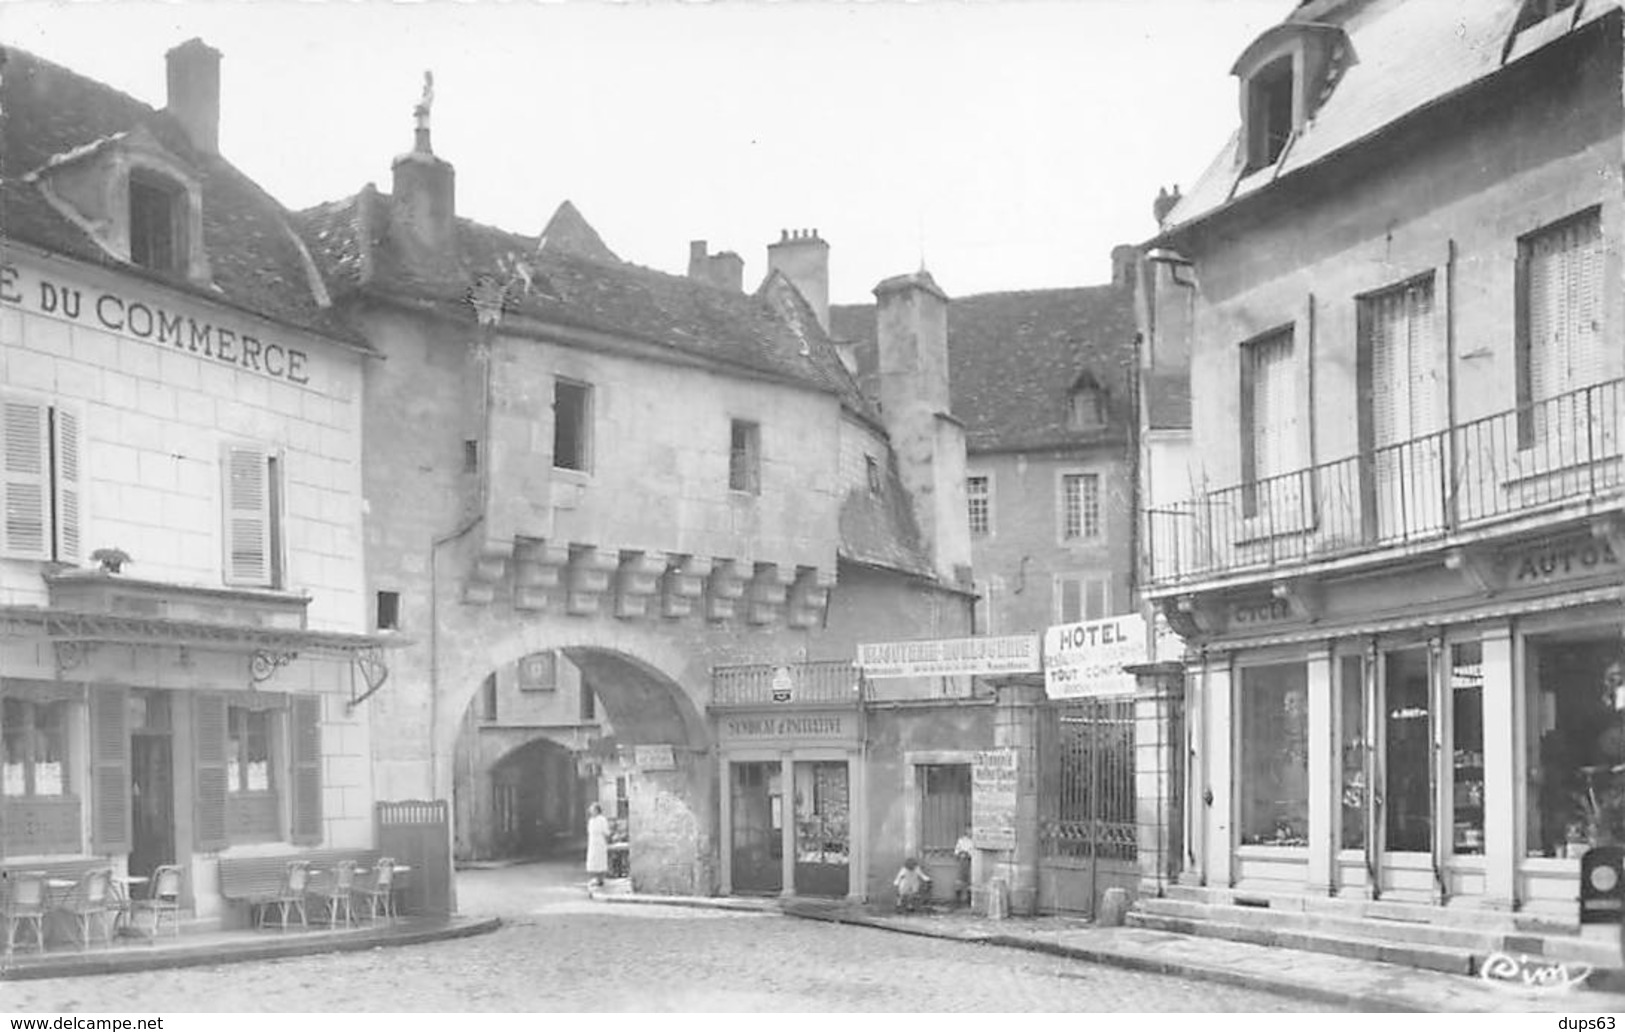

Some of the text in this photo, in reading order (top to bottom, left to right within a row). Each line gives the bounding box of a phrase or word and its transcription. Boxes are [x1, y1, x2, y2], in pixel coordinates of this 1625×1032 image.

[40, 281, 80, 318] DU
[97, 294, 310, 385] COMMERCE
[1060, 622, 1127, 651] HOTEL
[1051, 668, 1078, 683] TOUT
